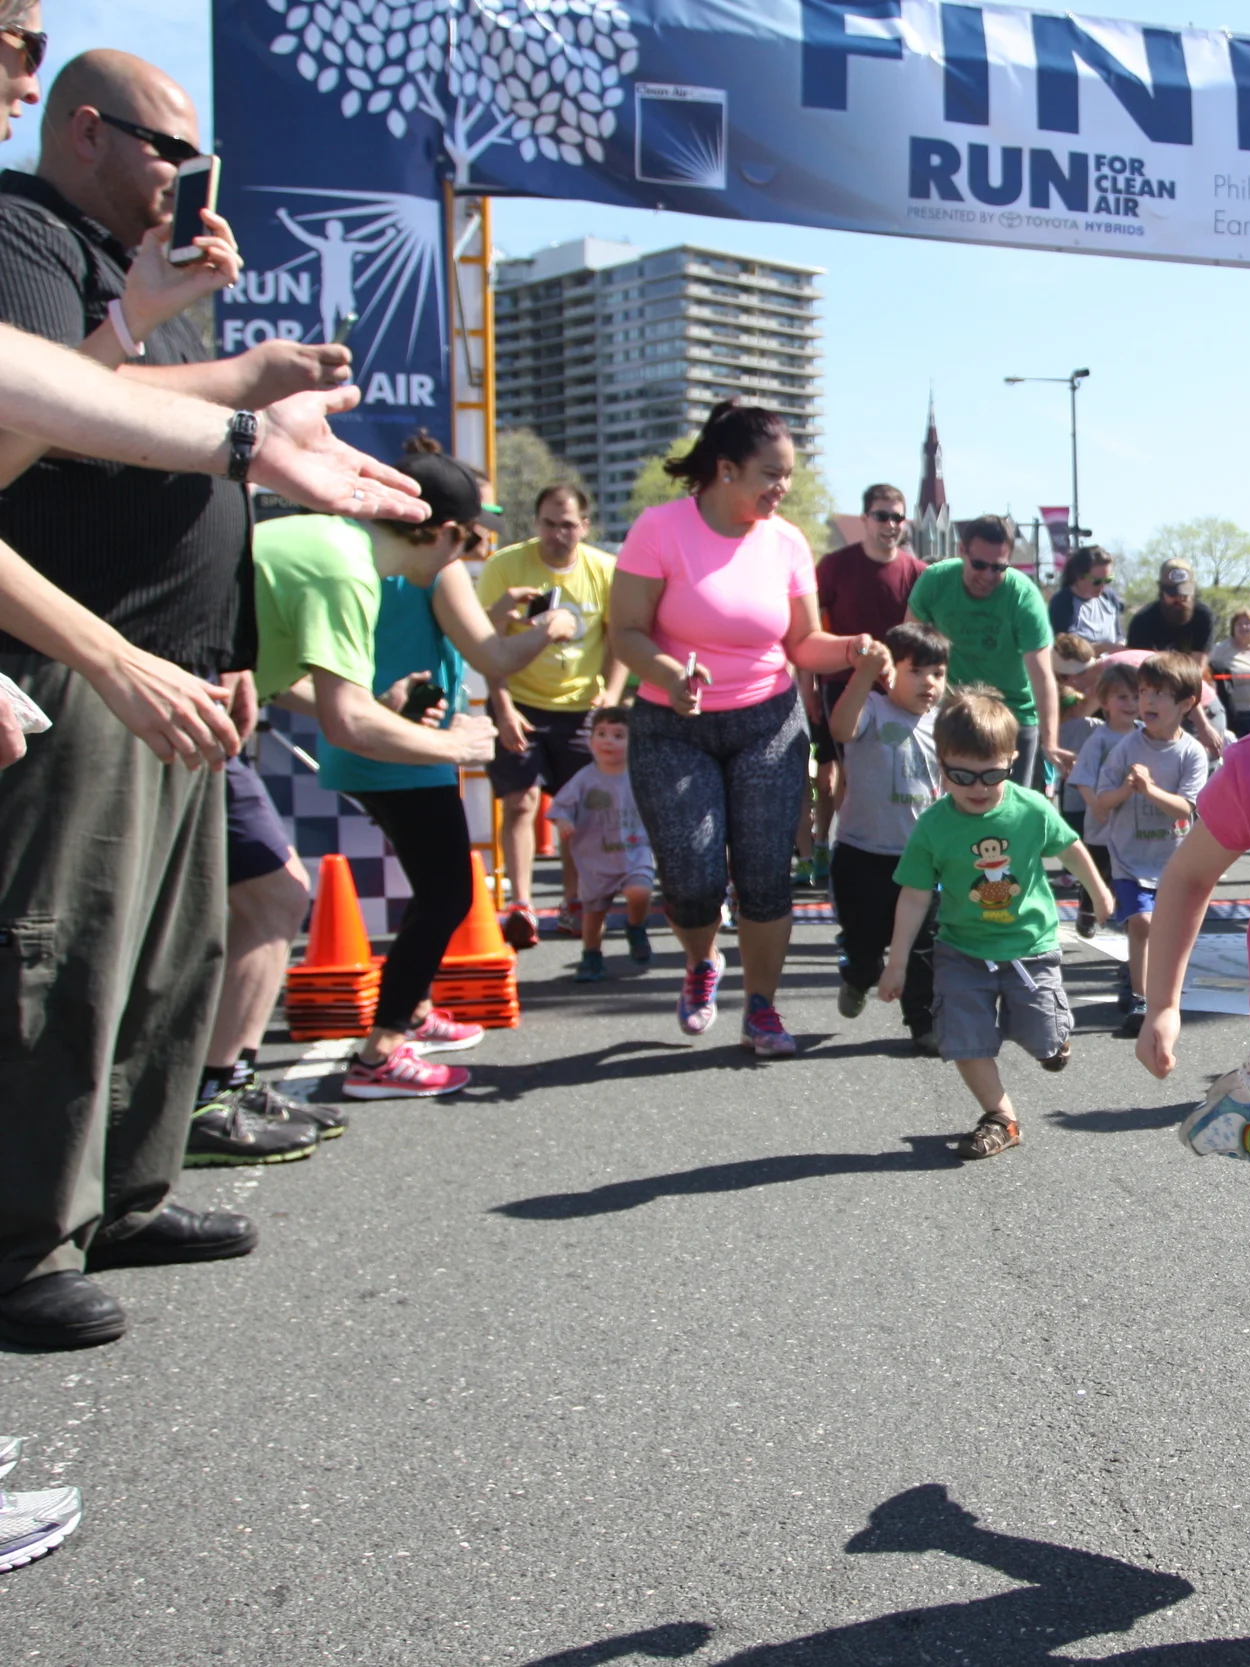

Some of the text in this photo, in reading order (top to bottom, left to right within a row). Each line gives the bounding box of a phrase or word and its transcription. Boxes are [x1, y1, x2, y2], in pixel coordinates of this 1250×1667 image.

[909, 135, 1089, 213] RUN
[1094, 154, 1146, 177] FOR
[1094, 175, 1176, 200] CLEAN
[907, 205, 1145, 236] PRESENTED BY TOYOTA HYBRIDS
[1093, 195, 1139, 217] AIR
[223, 271, 312, 304] RUN
[365, 372, 436, 407] AIR
